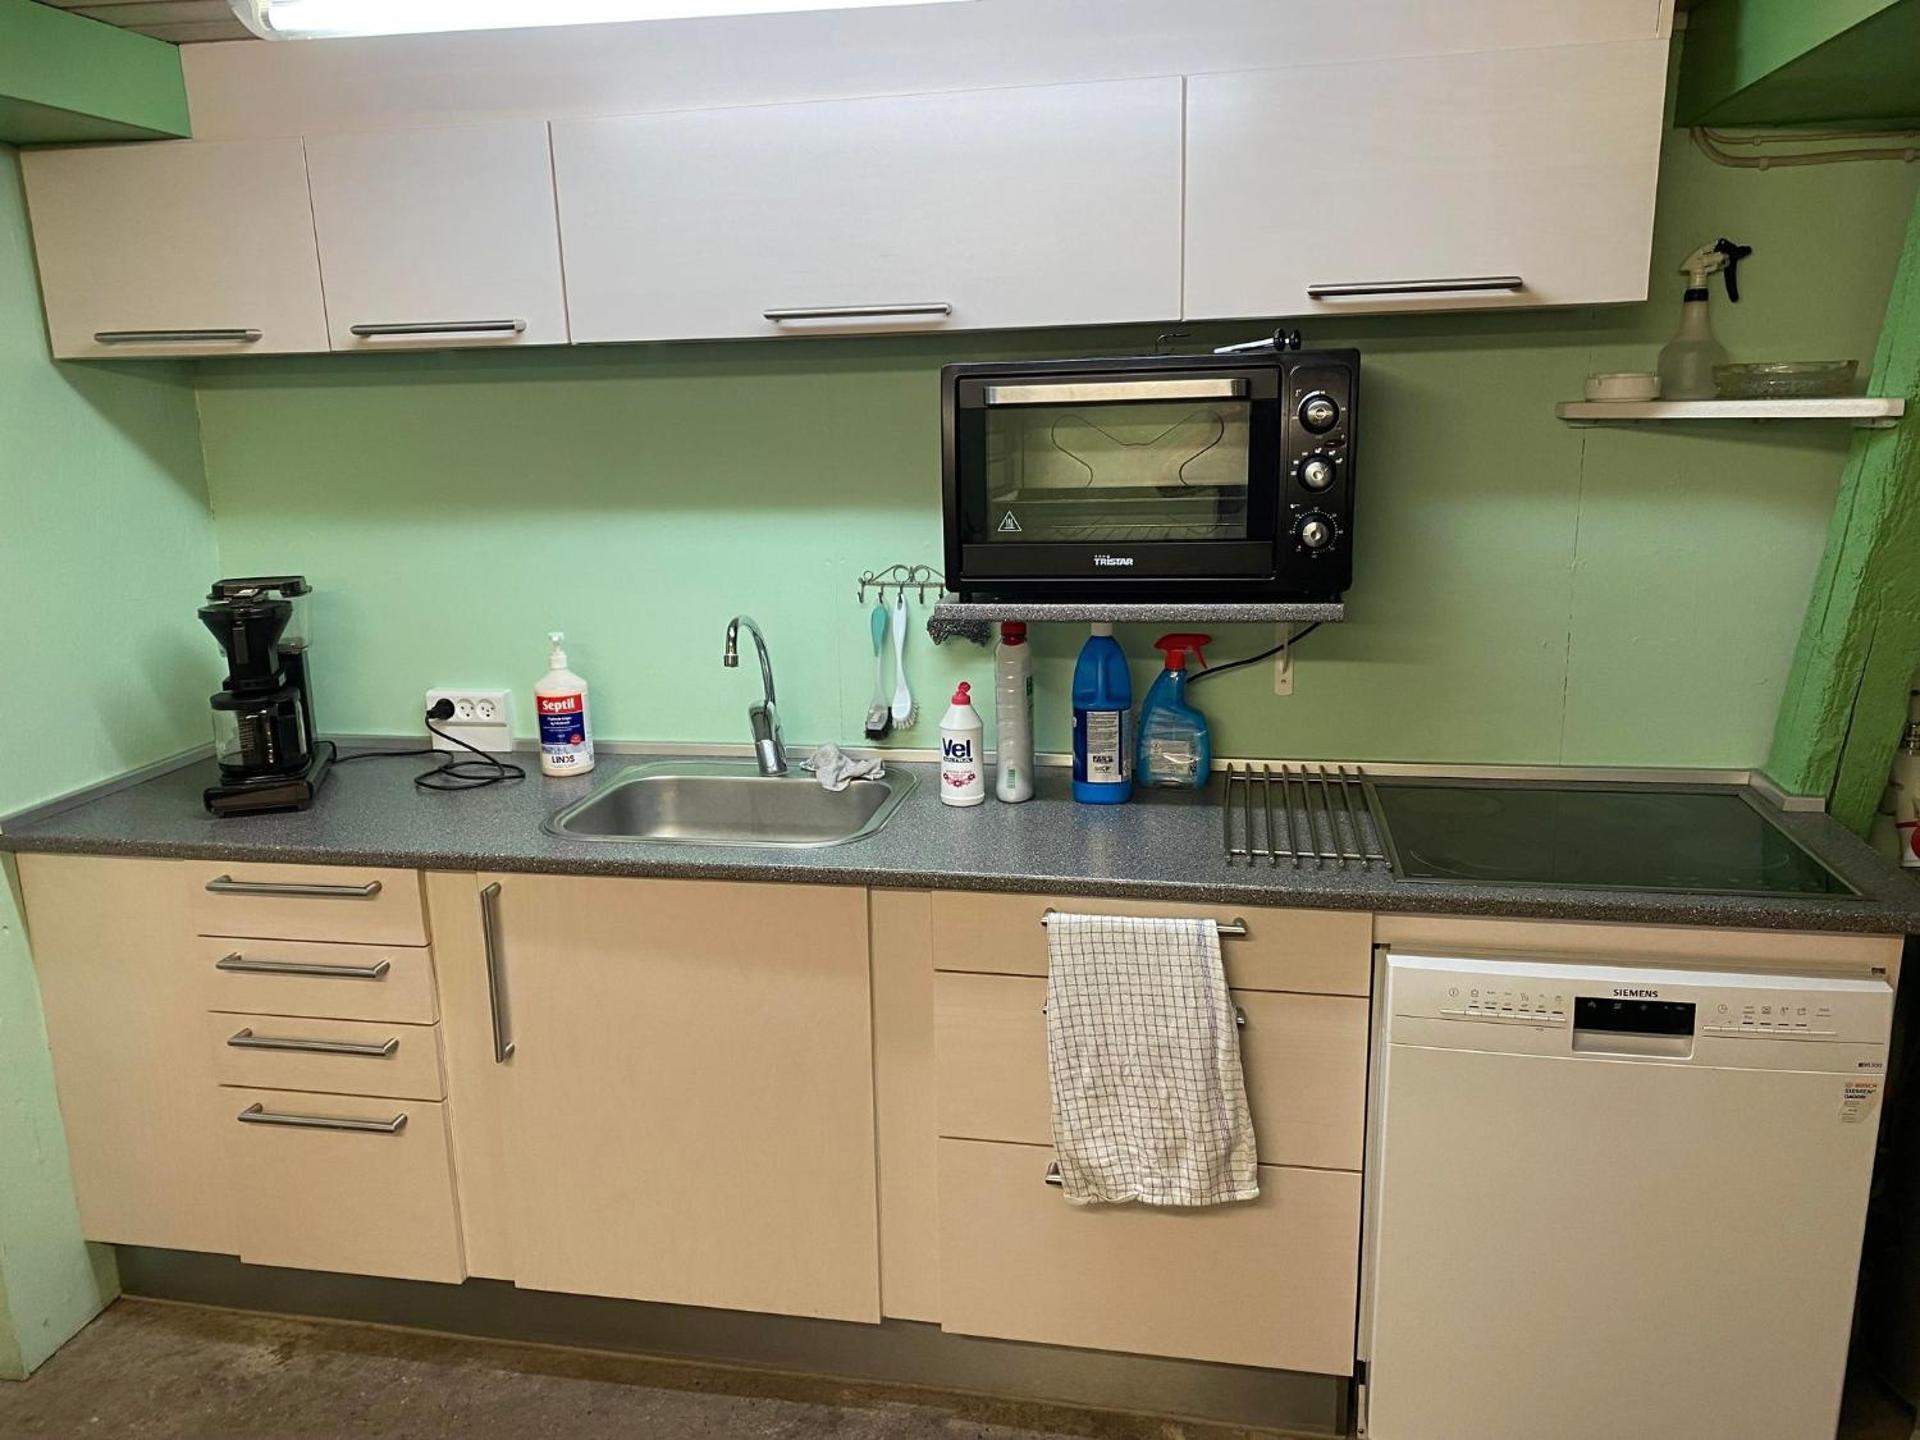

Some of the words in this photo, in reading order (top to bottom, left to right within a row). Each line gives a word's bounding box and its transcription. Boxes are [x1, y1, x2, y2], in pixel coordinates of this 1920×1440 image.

[1094, 555, 1134, 566] TRISTAR
[542, 698, 575, 713] Septil
[942, 738, 971, 758] Vel
[1613, 988, 1659, 998] SIEMENS
